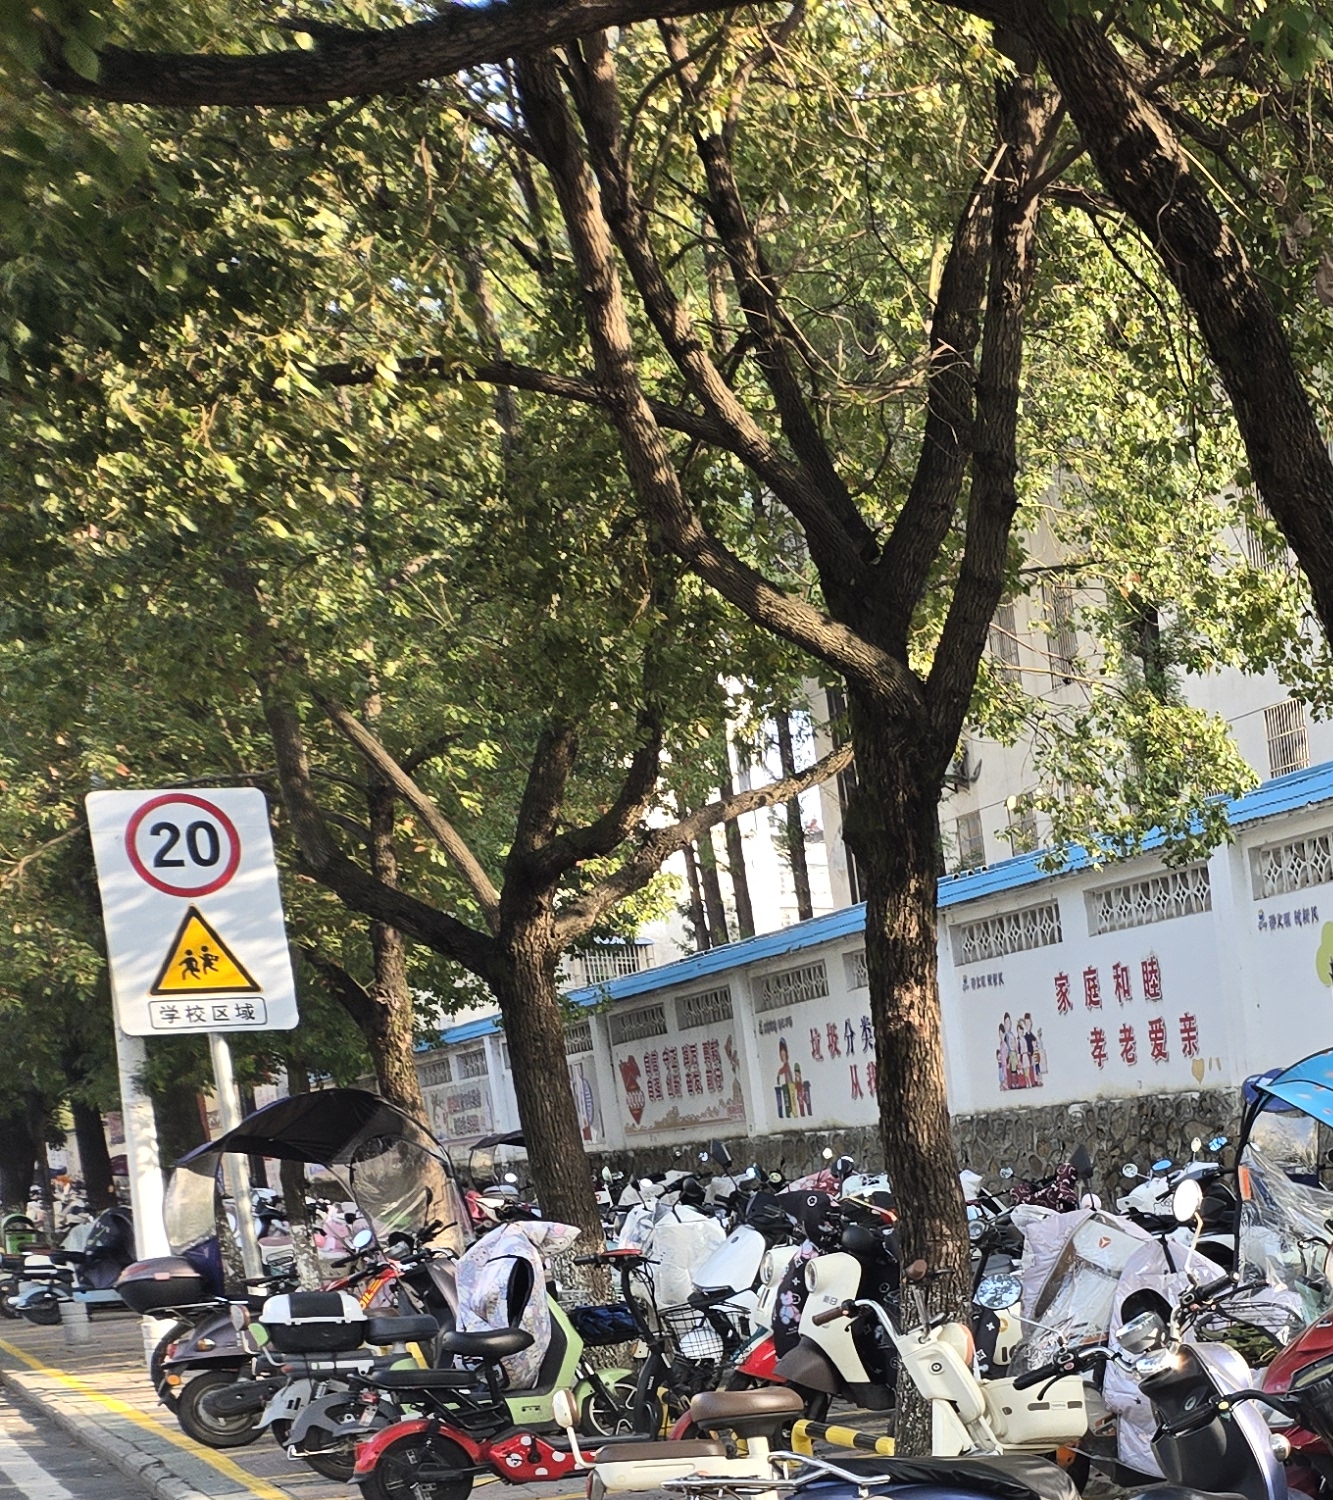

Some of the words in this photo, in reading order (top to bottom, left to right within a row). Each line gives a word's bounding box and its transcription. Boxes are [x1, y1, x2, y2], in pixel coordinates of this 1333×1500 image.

[149, 820, 220, 868] 20
[1054, 955, 1162, 1015] 家庭和睦
[159, 1002, 256, 1023] 学校区域
[1089, 1011, 1200, 1069] 孝老爱亲
